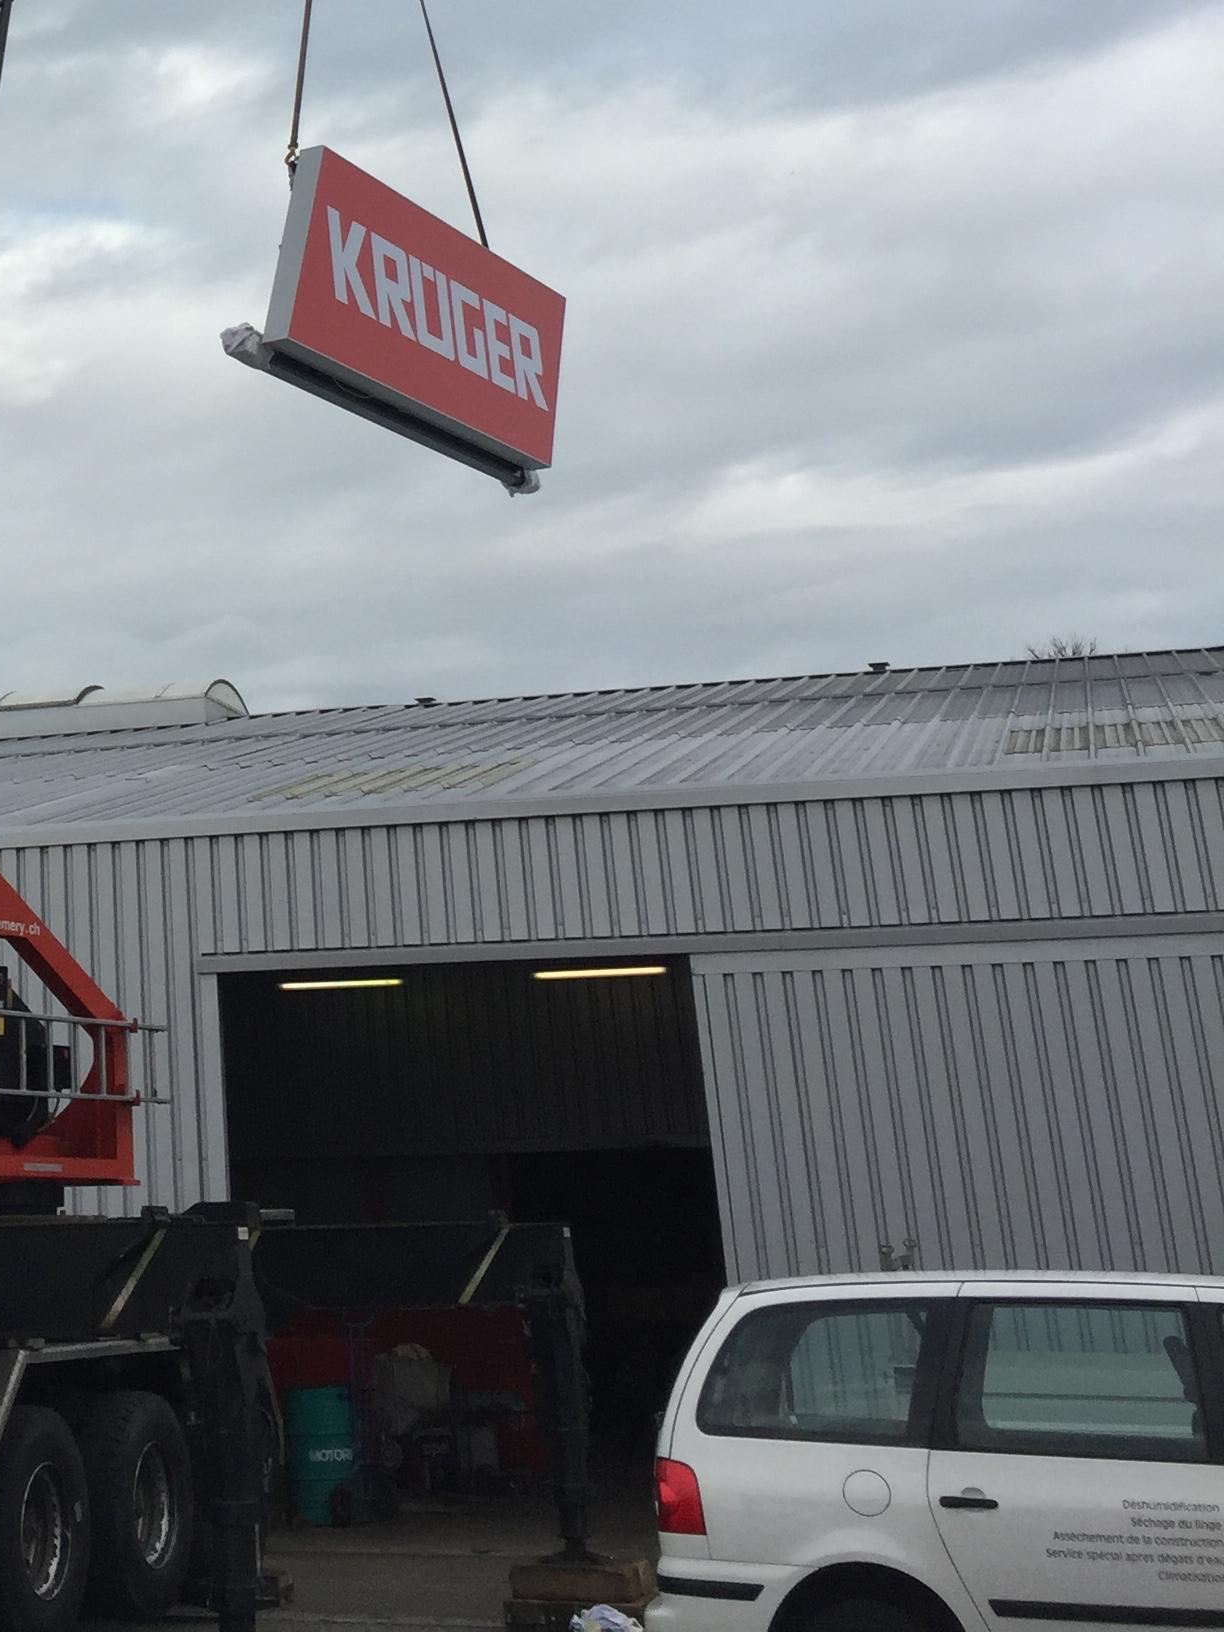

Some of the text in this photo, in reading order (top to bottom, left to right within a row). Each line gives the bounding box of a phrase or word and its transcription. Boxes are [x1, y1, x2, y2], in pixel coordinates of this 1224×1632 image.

[1178, 1519, 1192, 1530] du
[1195, 1519, 1223, 1532] linge
[1127, 1534, 1140, 1545] de
[1142, 1535, 1152, 1546] la
[1046, 1548, 1084, 1560] Service
